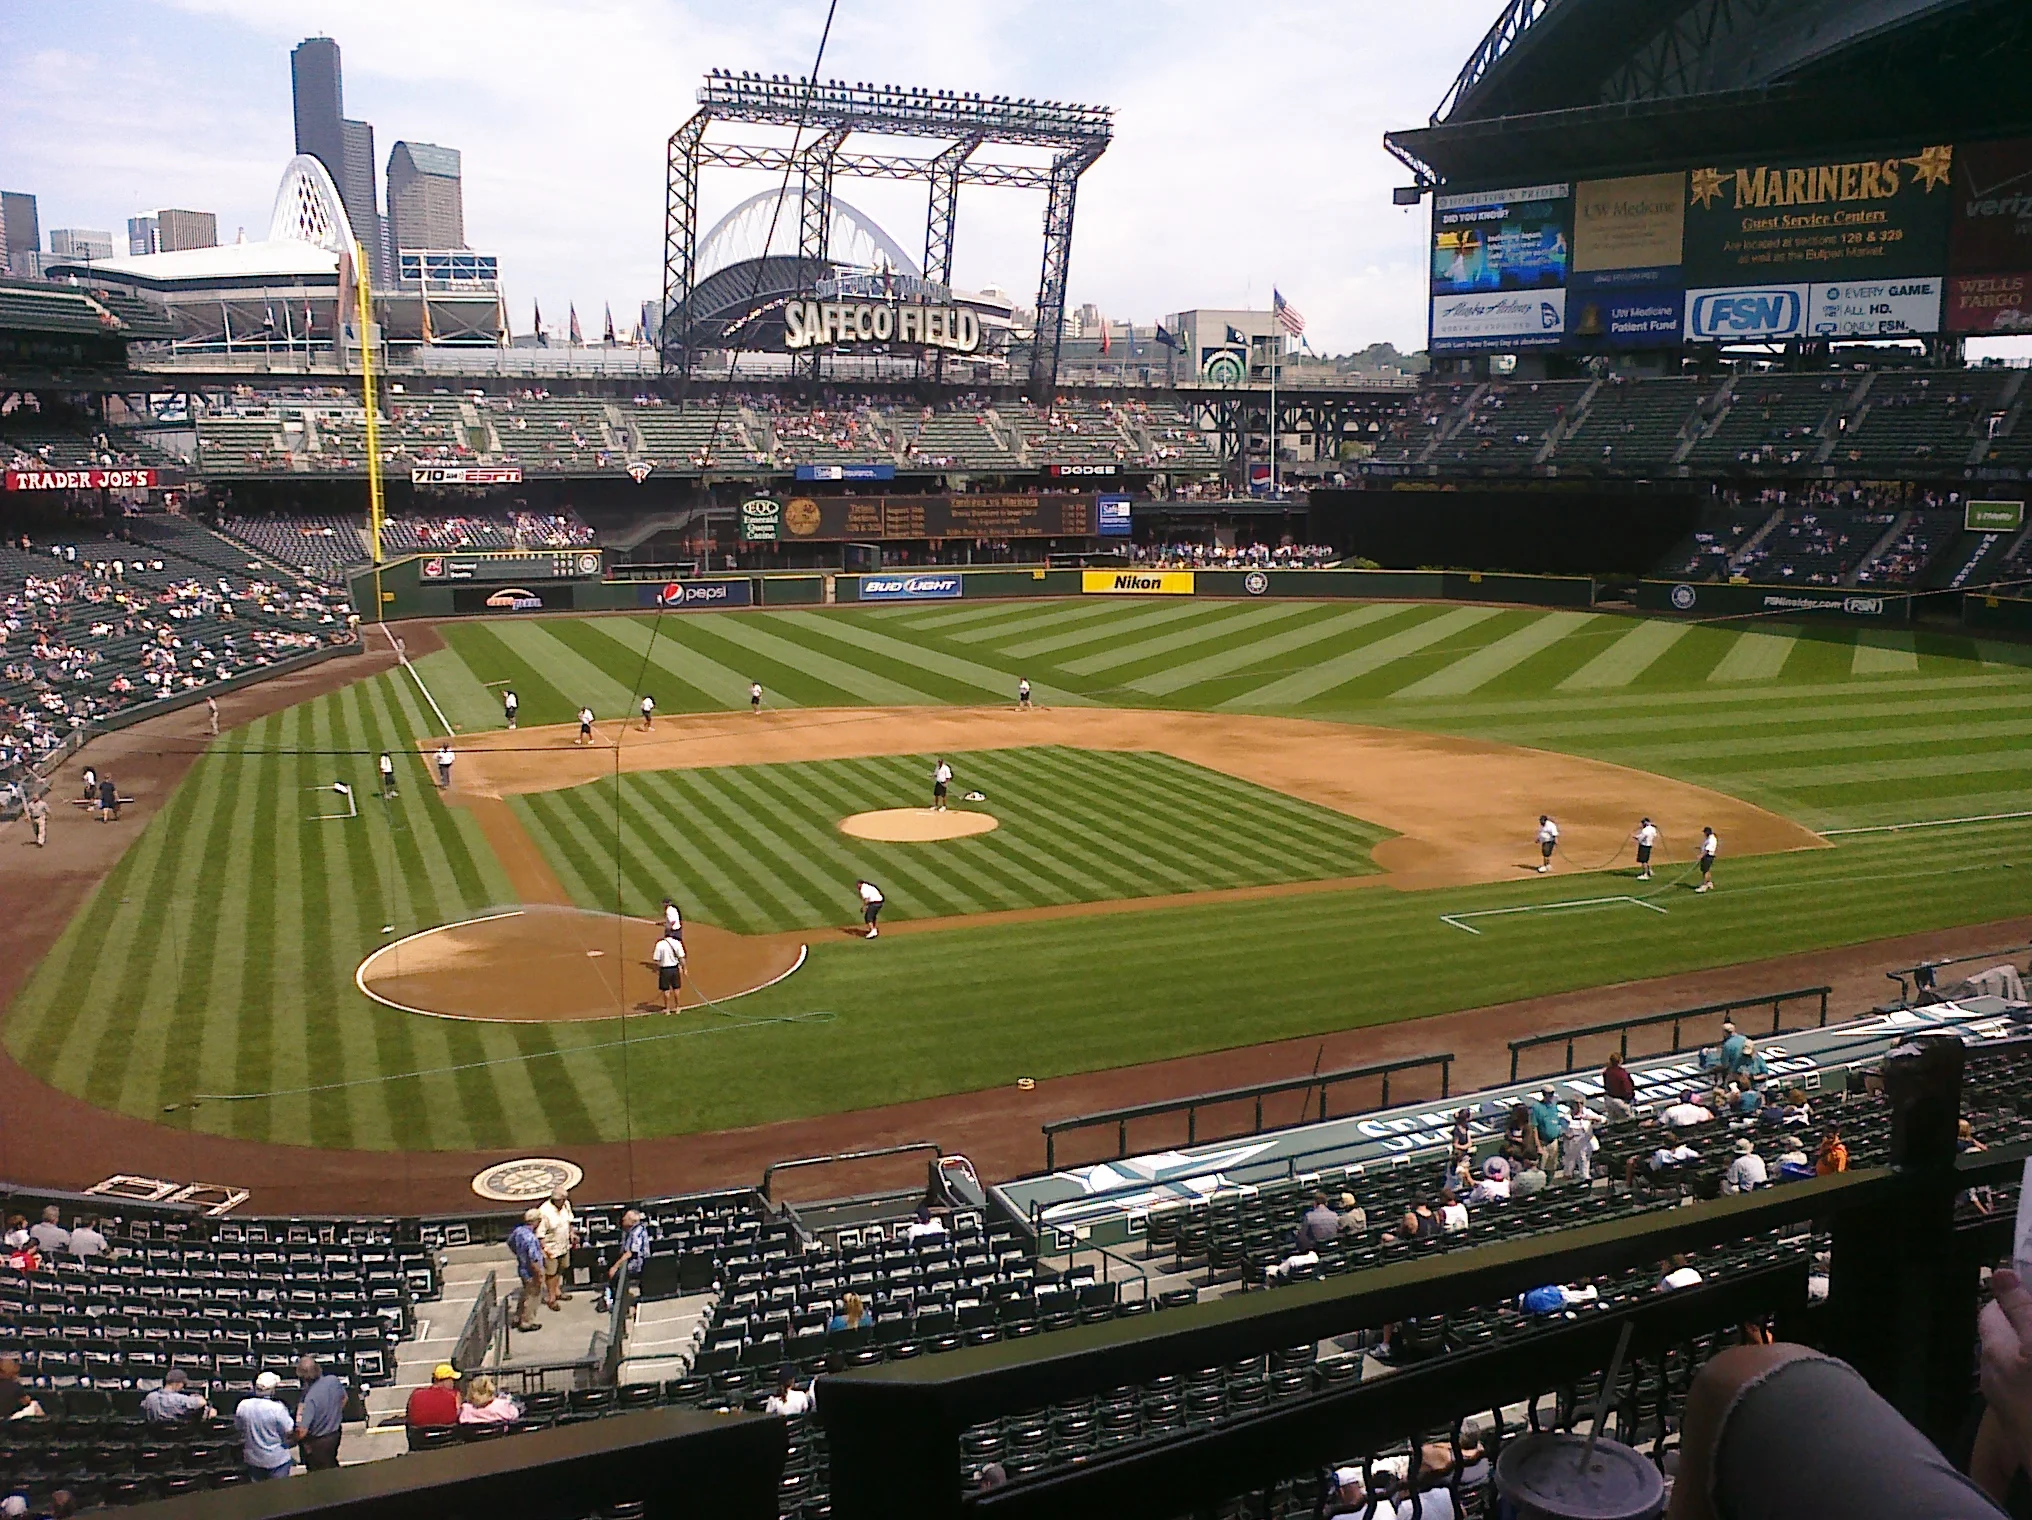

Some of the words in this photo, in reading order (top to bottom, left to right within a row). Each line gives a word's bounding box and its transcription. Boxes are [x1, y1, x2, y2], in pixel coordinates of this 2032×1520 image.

[1734, 158, 1900, 209] MARINERS
[1443, 214, 1459, 224] DID
[1459, 212, 1477, 222] YOU
[1742, 217, 1779, 230] Guest
[1782, 213, 1829, 227] Service
[1834, 210, 1887, 224] Centers
[1845, 287, 1883, 298] EVERY
[1889, 284, 1934, 296] GAME.
[1959, 278, 2023, 292] WELLS
[1612, 308, 1629, 319] UW
[1630, 307, 1673, 318] Medicine
[1708, 295, 1784, 332] FSN
[1844, 305, 1866, 316] ALL
[1869, 303, 1892, 315] HD.
[784, 300, 895, 349] SAFECO
[898, 305, 981, 353] FIELD
[1612, 321, 1648, 333] Patient
[1650, 319, 1677, 331] Fund
[1843, 321, 1875, 332] ONLY
[415, 470, 445, 481] 710
[466, 469, 520, 481] ESPN
[1061, 465, 1116, 475] DODGE
[16, 472, 92, 490] TRADER
[98, 470, 149, 487] JOE'S
[744, 515, 779, 524] Emerald
[747, 523, 775, 532] Queen
[746, 531, 777, 540] Casino
[865, 581, 903, 593] BUD
[909, 580, 957, 591] LIGHT
[1114, 575, 1161, 590] Nikon
[686, 586, 727, 602] pepsi
[1850, 600, 1877, 612] FSN
